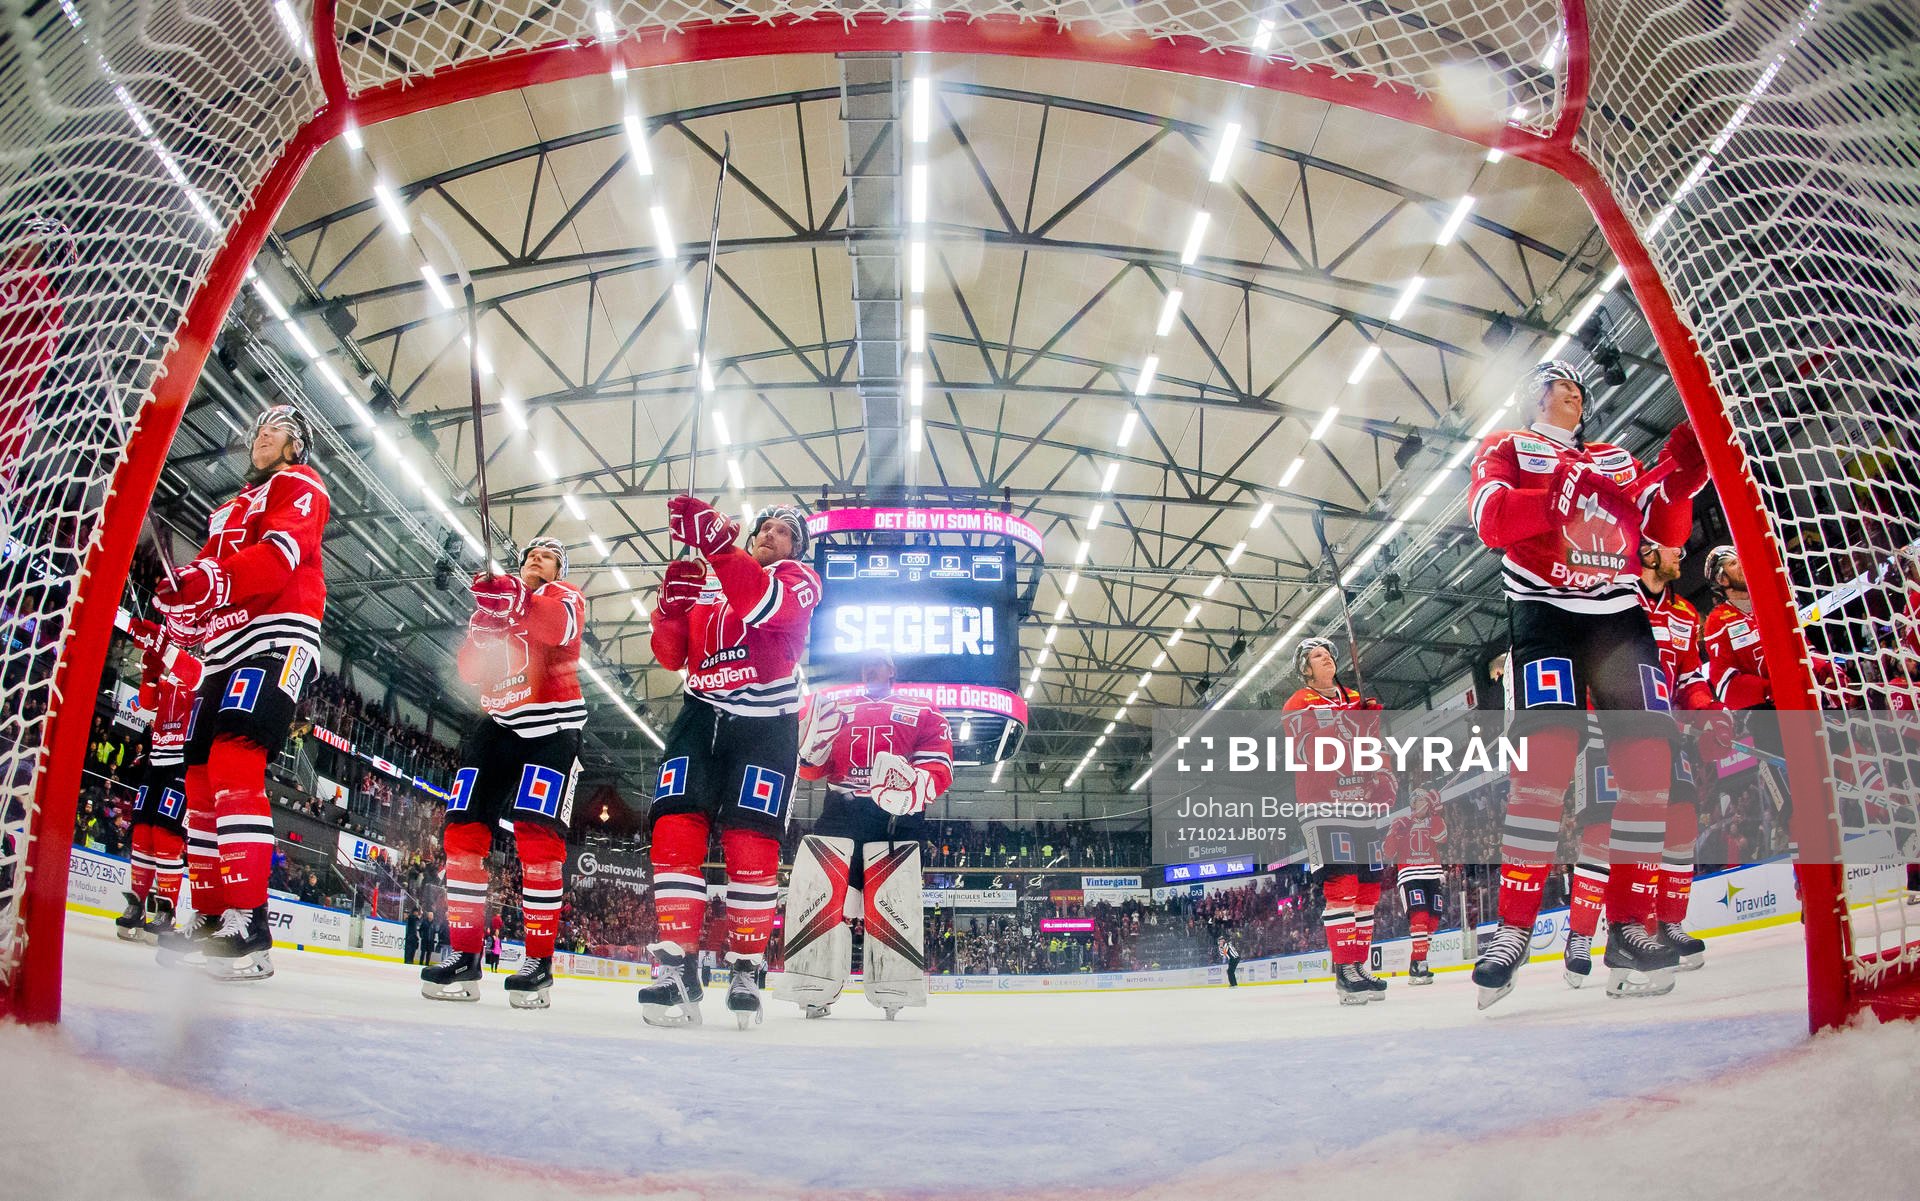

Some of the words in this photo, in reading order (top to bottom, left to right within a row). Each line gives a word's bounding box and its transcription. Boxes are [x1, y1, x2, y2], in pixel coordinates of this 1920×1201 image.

[294, 492, 313, 517] 4
[875, 513, 901, 528] DET
[906, 511, 926, 529] ÄR
[930, 514, 944, 528] VI
[947, 513, 981, 529] SOM
[983, 512, 1002, 530] ÄR
[876, 558, 884, 567] 3
[906, 556, 926, 564] 0:00
[945, 559, 953, 568] 2
[1571, 550, 1626, 569] ÖREBRO
[791, 580, 814, 609] 18
[834, 605, 994, 656] SEGER!
[701, 648, 746, 669] ÖREBRO
[936, 685, 953, 706] ÄR
[960, 686, 1013, 714] ÖREBRO
[1201, 846, 1227, 856] Strateg
[577, 852, 646, 880] Gustavsvik
[1173, 867, 1191, 879] NA
[1199, 864, 1217, 876] NA
[1226, 861, 1245, 873] NA
[1086, 877, 1138, 888] Vintergatan
[982, 891, 1001, 899] Let's
[1735, 890, 1777, 914] bravida
[799, 892, 828, 924] BAUER
[878, 899, 910, 931] BAUER
